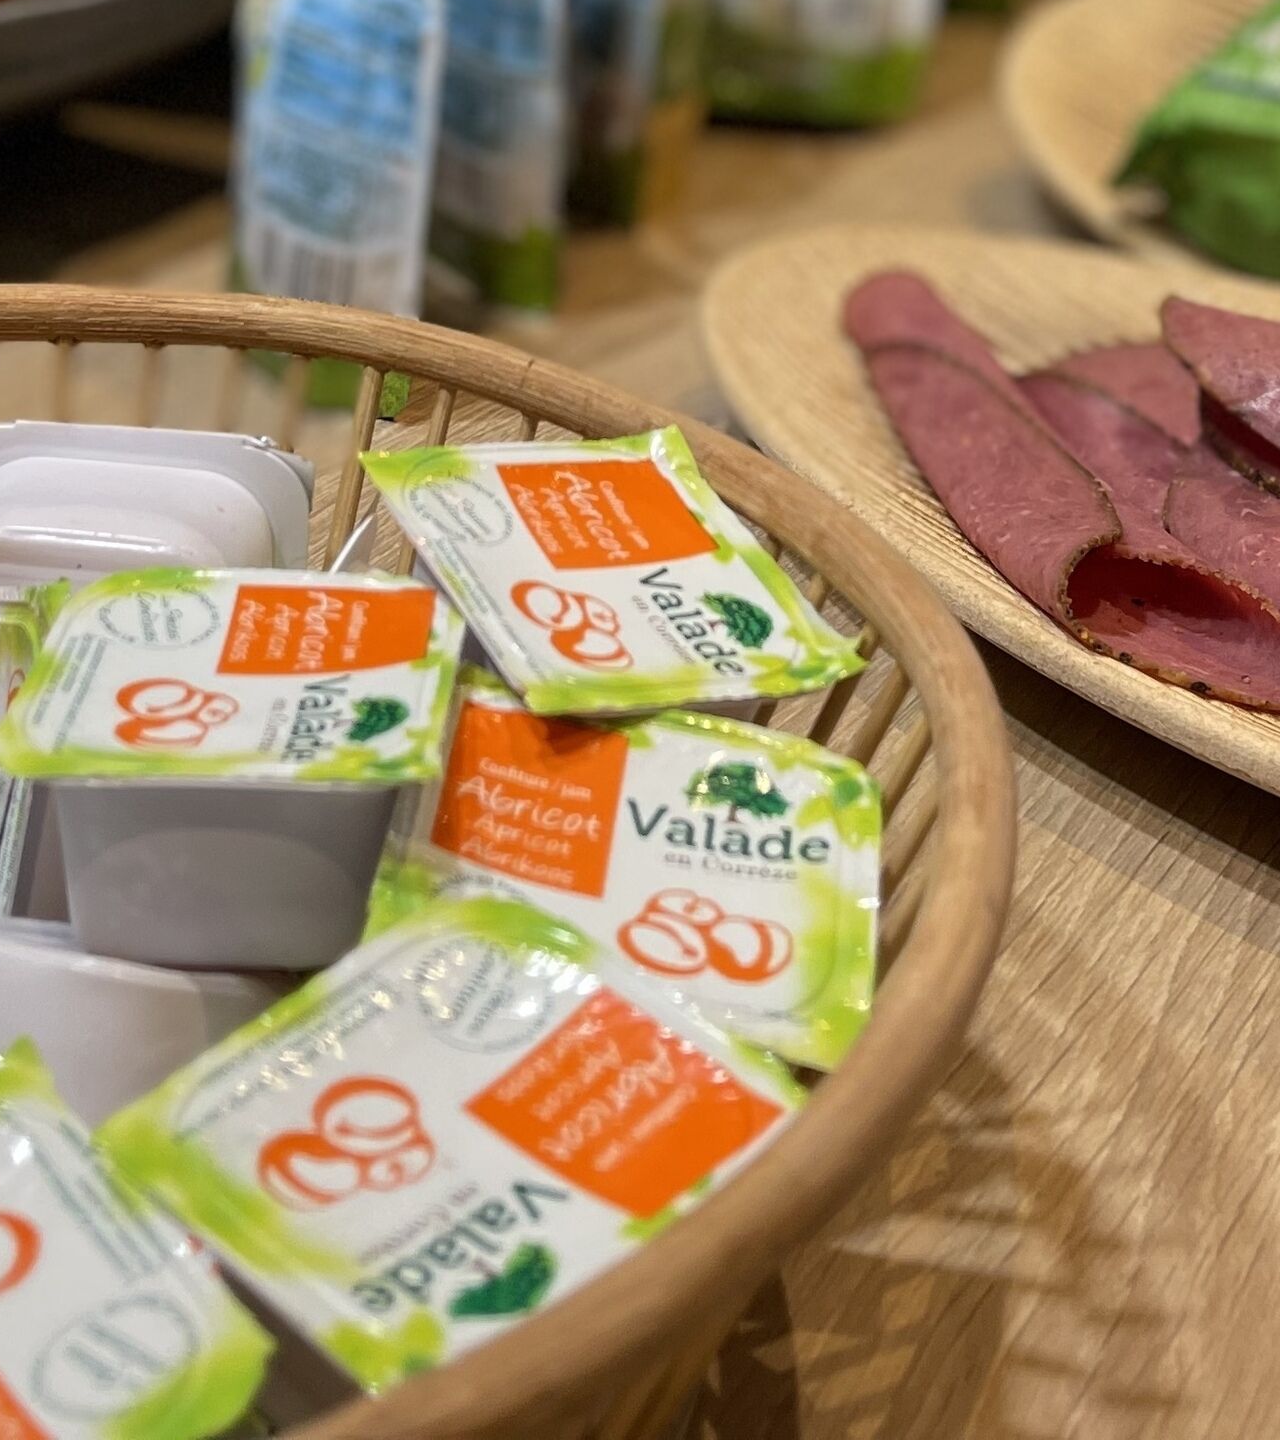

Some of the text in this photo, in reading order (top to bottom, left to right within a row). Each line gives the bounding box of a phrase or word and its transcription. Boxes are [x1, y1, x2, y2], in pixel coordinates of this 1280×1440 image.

[551, 470, 630, 561] Abricot
[294, 590, 345, 671] Abricot
[639, 567, 746, 677] Valade
[280, 673, 352, 762] Valade
[456, 775, 601, 843] Abricot
[473, 812, 571, 858] Apricot
[627, 797, 831, 863] Valade
[351, 1180, 570, 1314] Valade
